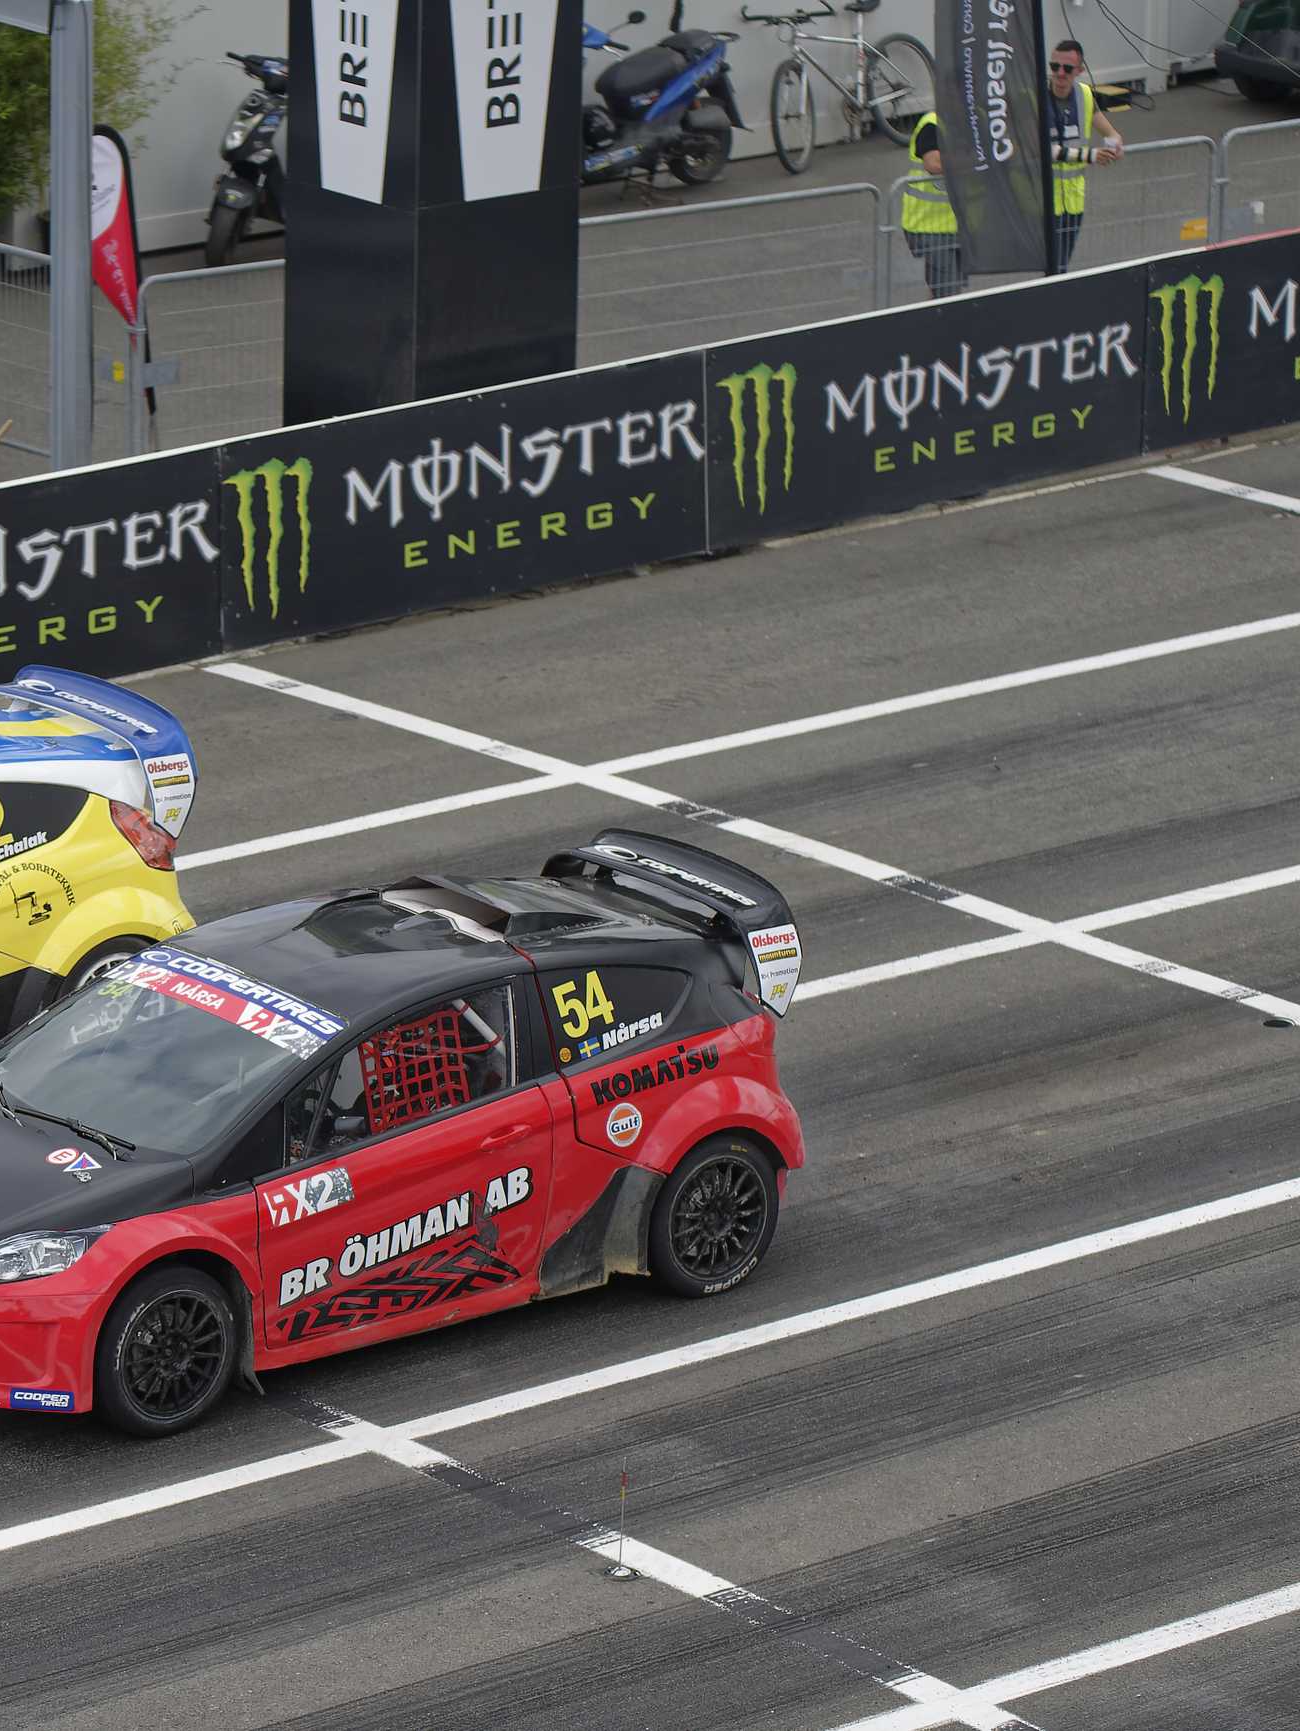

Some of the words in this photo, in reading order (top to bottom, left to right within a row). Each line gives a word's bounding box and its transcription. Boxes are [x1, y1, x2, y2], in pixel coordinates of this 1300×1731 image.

[340, 0, 368, 127] BRE
[486, 0, 522, 128] BRE
[825, 320, 1138, 436] MONSTER
[344, 400, 705, 527] MONSTER
[875, 404, 1094, 472] ENERGY
[404, 493, 657, 568] ENERGY
[147, 759, 189, 775] Olsbergs
[12, 865, 20, 874] &
[20, 862, 76, 906] BORRTEKNIK
[751, 932, 795, 949] Olsbergs
[97, 980, 132, 999] 54
[167, 956, 344, 1036] COOPERTIRES
[170, 982, 225, 1010] NÅRSA
[552, 970, 614, 1038] 54
[602, 1011, 664, 1051] Nårsa
[591, 1044, 719, 1105] KOMATSU
[611, 1116, 640, 1133] Gulf
[280, 1256, 332, 1308] BR
[338, 1190, 474, 1277] ÖHMAN
[482, 1166, 533, 1218] AB
[703, 1256, 758, 1294] COOPER
[14, 1391, 70, 1403] COOPER
[41, 1400, 69, 1408] TIRES
